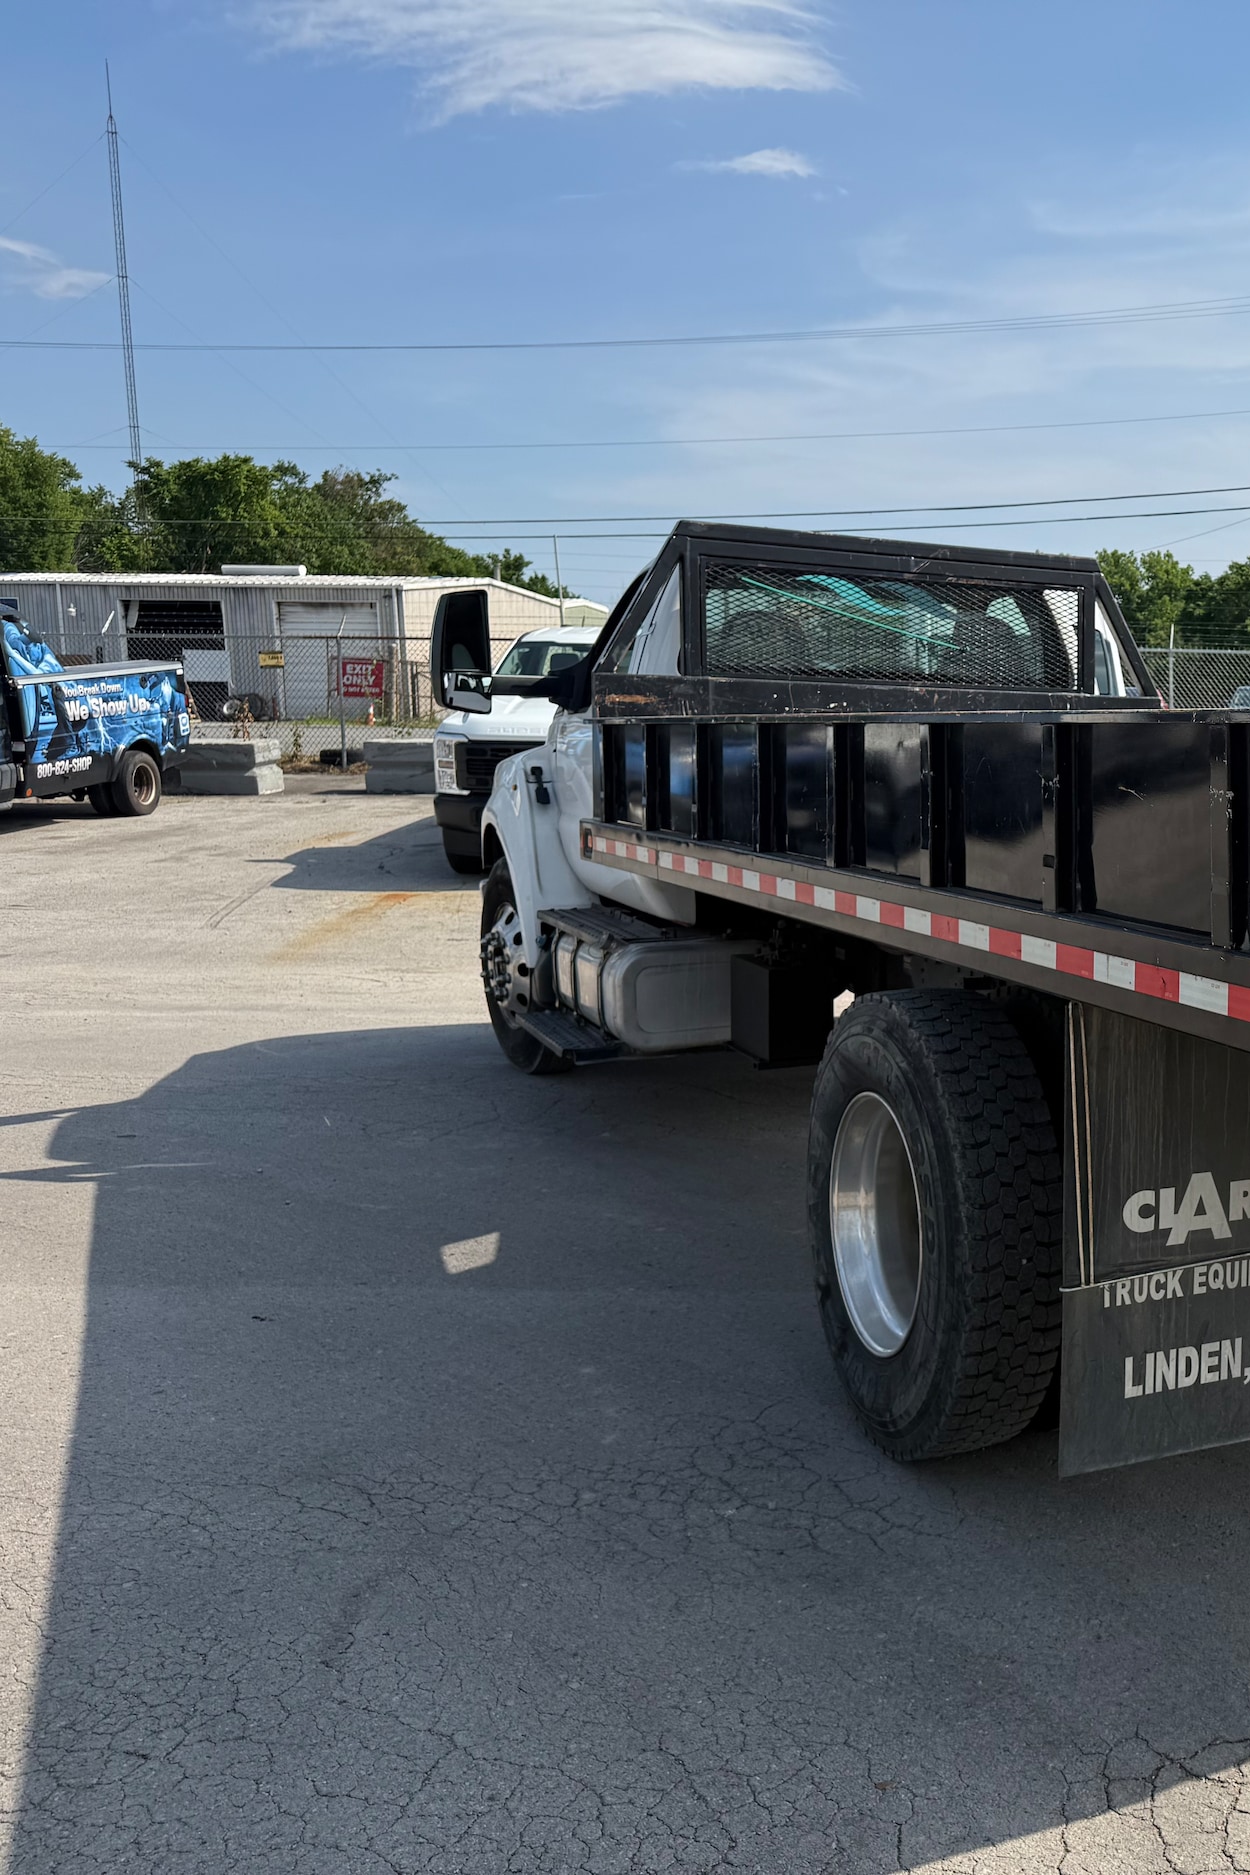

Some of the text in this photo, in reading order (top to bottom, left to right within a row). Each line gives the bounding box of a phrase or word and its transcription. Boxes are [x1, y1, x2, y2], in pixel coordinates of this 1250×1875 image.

[346, 663, 373, 675] EXIT
[343, 674, 376, 686] ONLY
[62, 682, 123, 698] You Break Down.
[64, 701, 89, 722] We
[90, 697, 127, 718] Show
[37, 756, 93, 779] 800-824-SHOP
[1100, 1269, 1184, 1308] TRUCK
